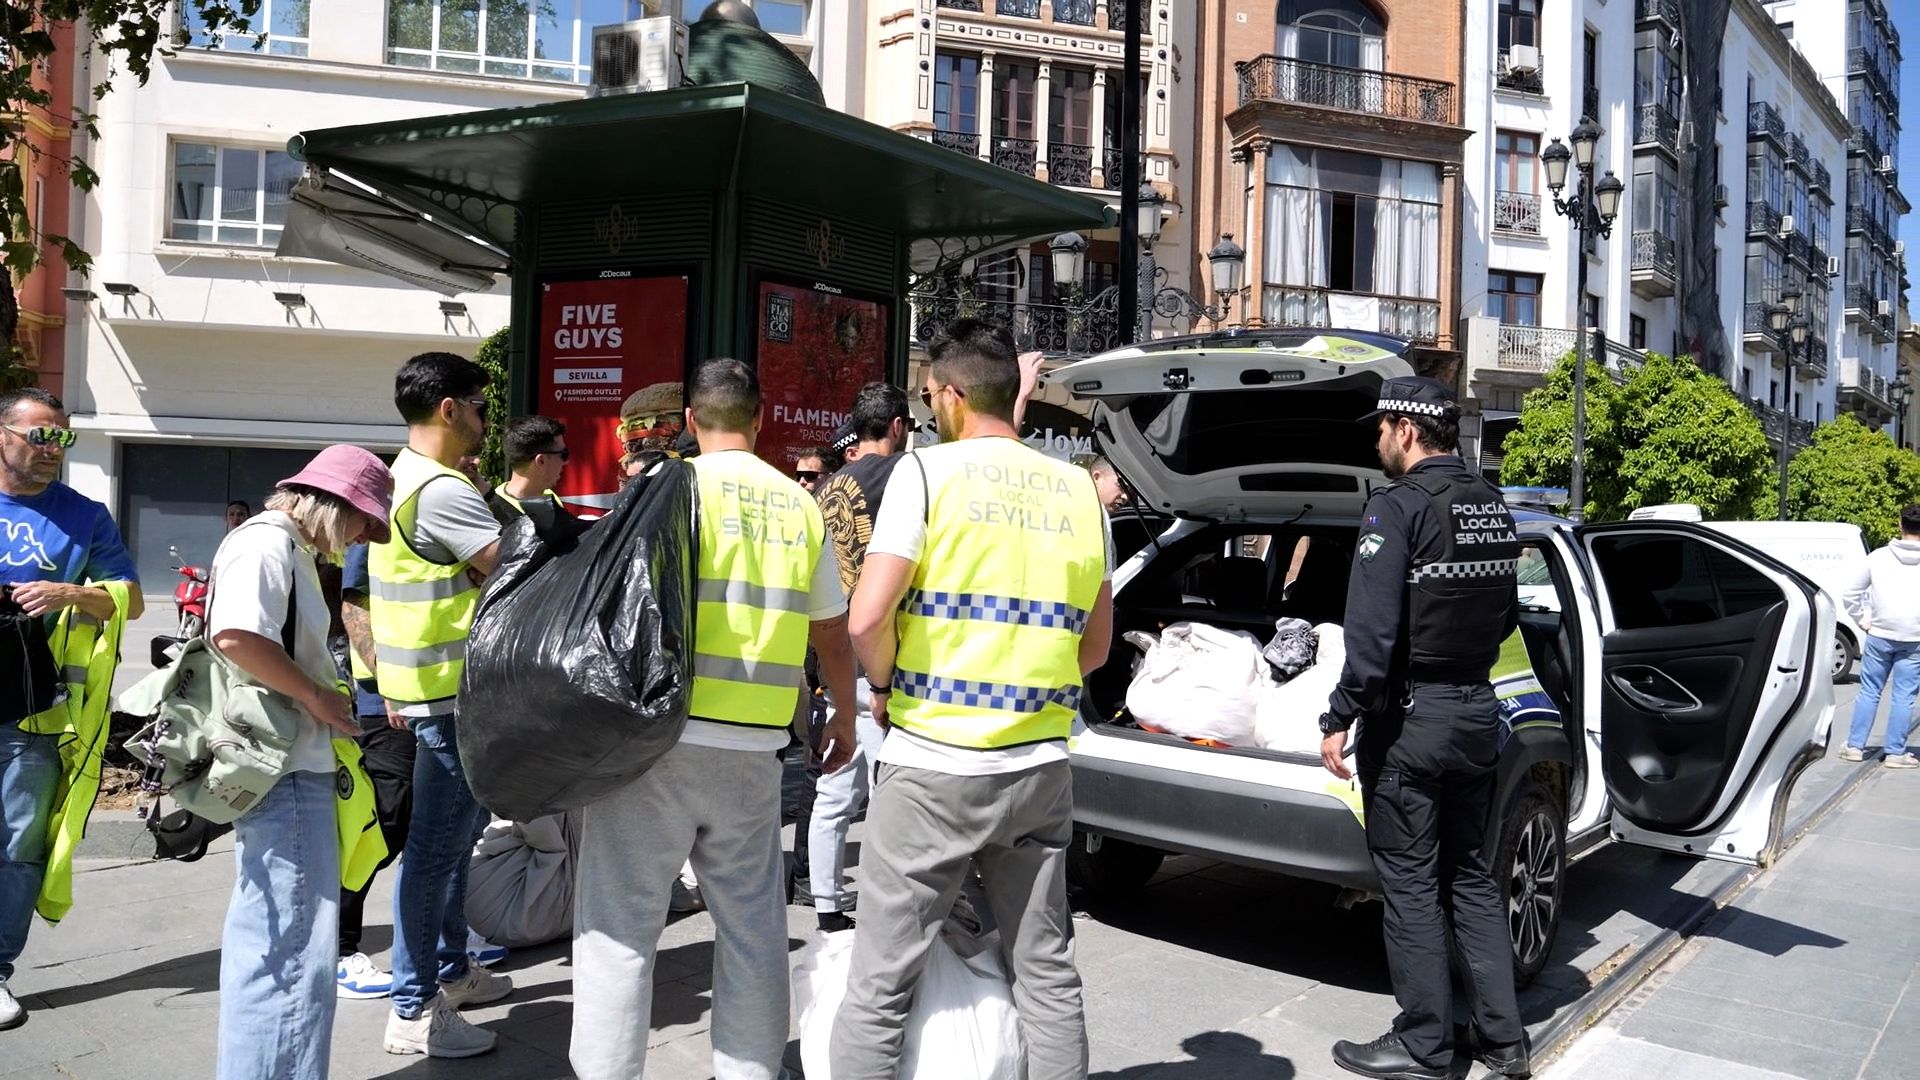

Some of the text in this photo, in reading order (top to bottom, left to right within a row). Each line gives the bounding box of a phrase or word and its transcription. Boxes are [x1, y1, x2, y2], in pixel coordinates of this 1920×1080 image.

[599, 270, 631, 278] JCDecaux
[813, 282, 842, 294] JCDecaux
[562, 304, 617, 325] FIVE
[554, 327, 622, 349] GUYS
[569, 372, 607, 380] SEVILLA
[964, 462, 1072, 497] POLICIA
[721, 481, 803, 512] POLICIA
[1000, 490, 1043, 507] LOCAL
[742, 508, 784, 522] LOCAL
[1452, 501, 1508, 515] POLICÍA
[968, 501, 1074, 537] SEVILLA
[1459, 518, 1507, 530] LOCAL
[722, 518, 808, 548] SEVILLA
[1455, 531, 1517, 545] SEVILLA
